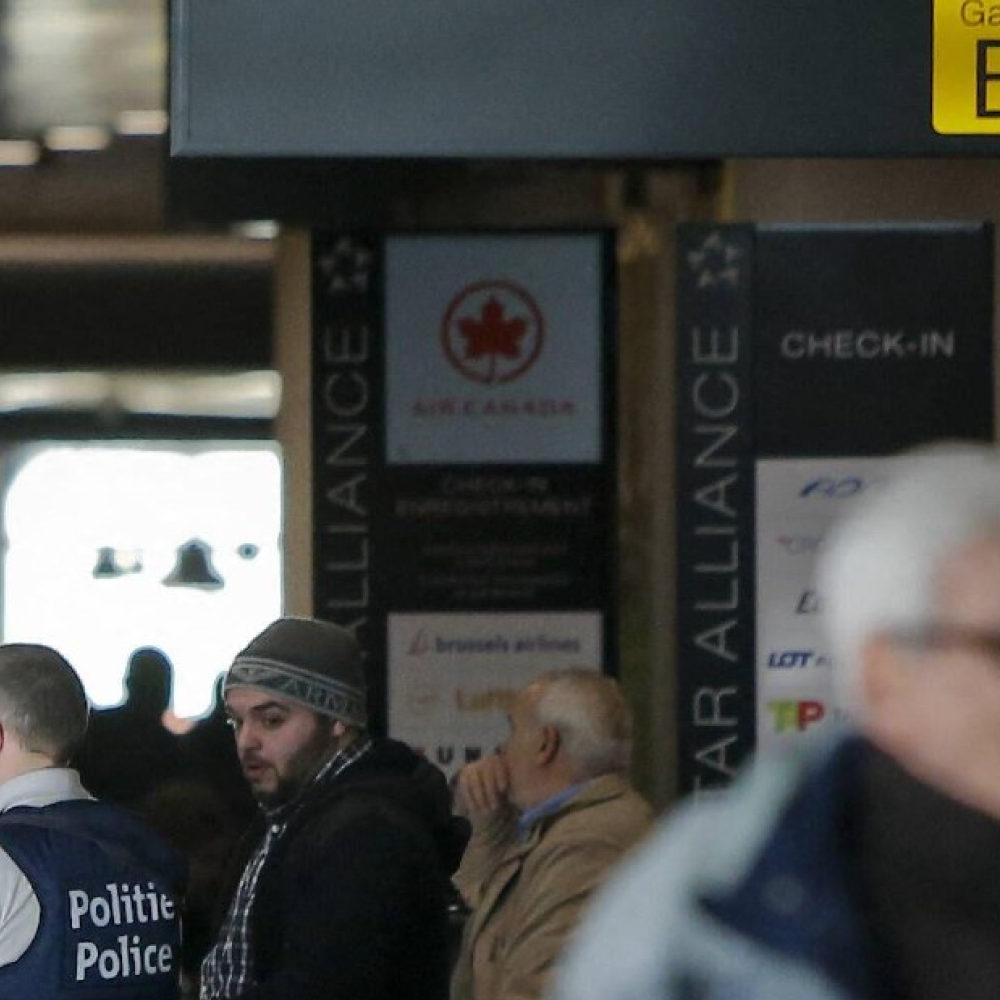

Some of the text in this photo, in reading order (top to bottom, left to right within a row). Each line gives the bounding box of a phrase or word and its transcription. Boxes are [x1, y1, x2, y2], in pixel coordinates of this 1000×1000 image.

[780, 330, 956, 360] CHECK-IN
[694, 327, 740, 810] TAR ALLIANCE
[68, 882, 175, 929] Politie
[76, 935, 173, 981] Police
